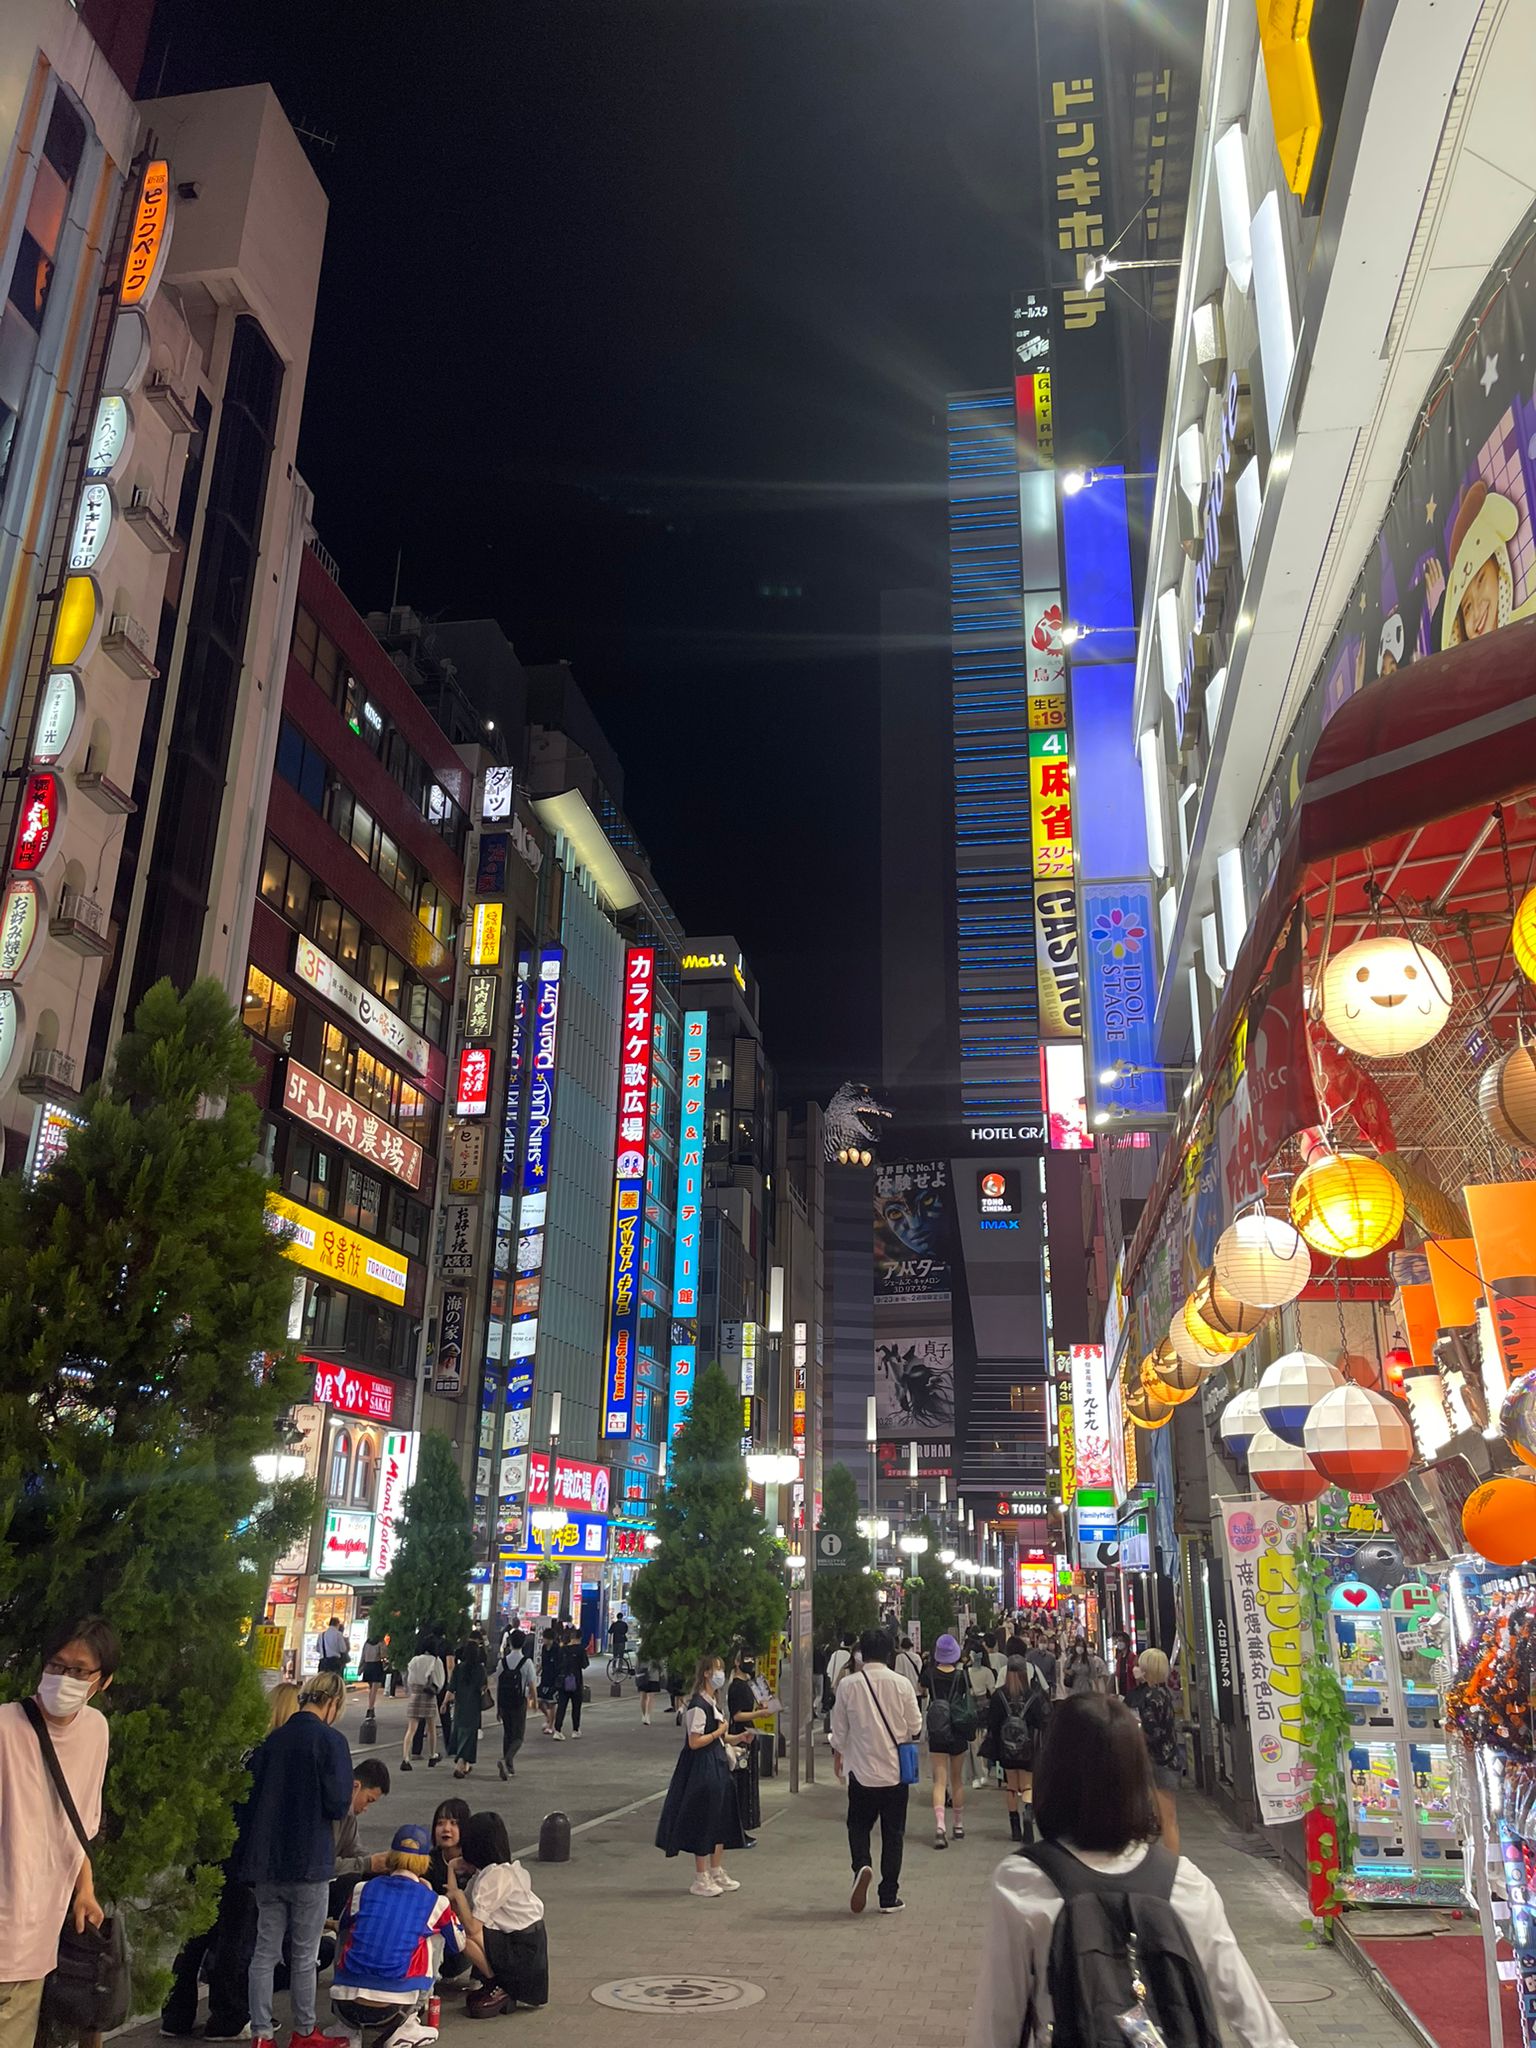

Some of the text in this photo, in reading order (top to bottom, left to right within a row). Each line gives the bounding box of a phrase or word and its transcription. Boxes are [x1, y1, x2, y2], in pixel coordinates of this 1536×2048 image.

[72, 555, 96, 568] 6F
[488, 770, 507, 812] ダーツ
[303, 949, 326, 983] 3F
[1102, 974, 1126, 1041] STAGE
[1122, 974, 1146, 1028] IDOL
[621, 955, 651, 1142] カラオケ歌広場
[288, 1072, 308, 1104] 5F
[306, 1083, 405, 1178] 山内農場
[971, 1128, 1016, 1141] HOTEL
[457, 1180, 473, 1192] 3F
[980, 1219, 1020, 1231] IMAX
[445, 1296, 462, 1340] 海の家
[923, 1340, 950, 1360] 貞子
[369, 1396, 391, 1413] SAKAI
[1083, 1398, 1099, 1431] 九十九
[901, 1444, 951, 1458] MRUHAN
[1012, 1504, 1041, 1514] TOHO
[1217, 1619, 1230, 1677] 入口はコチラ
